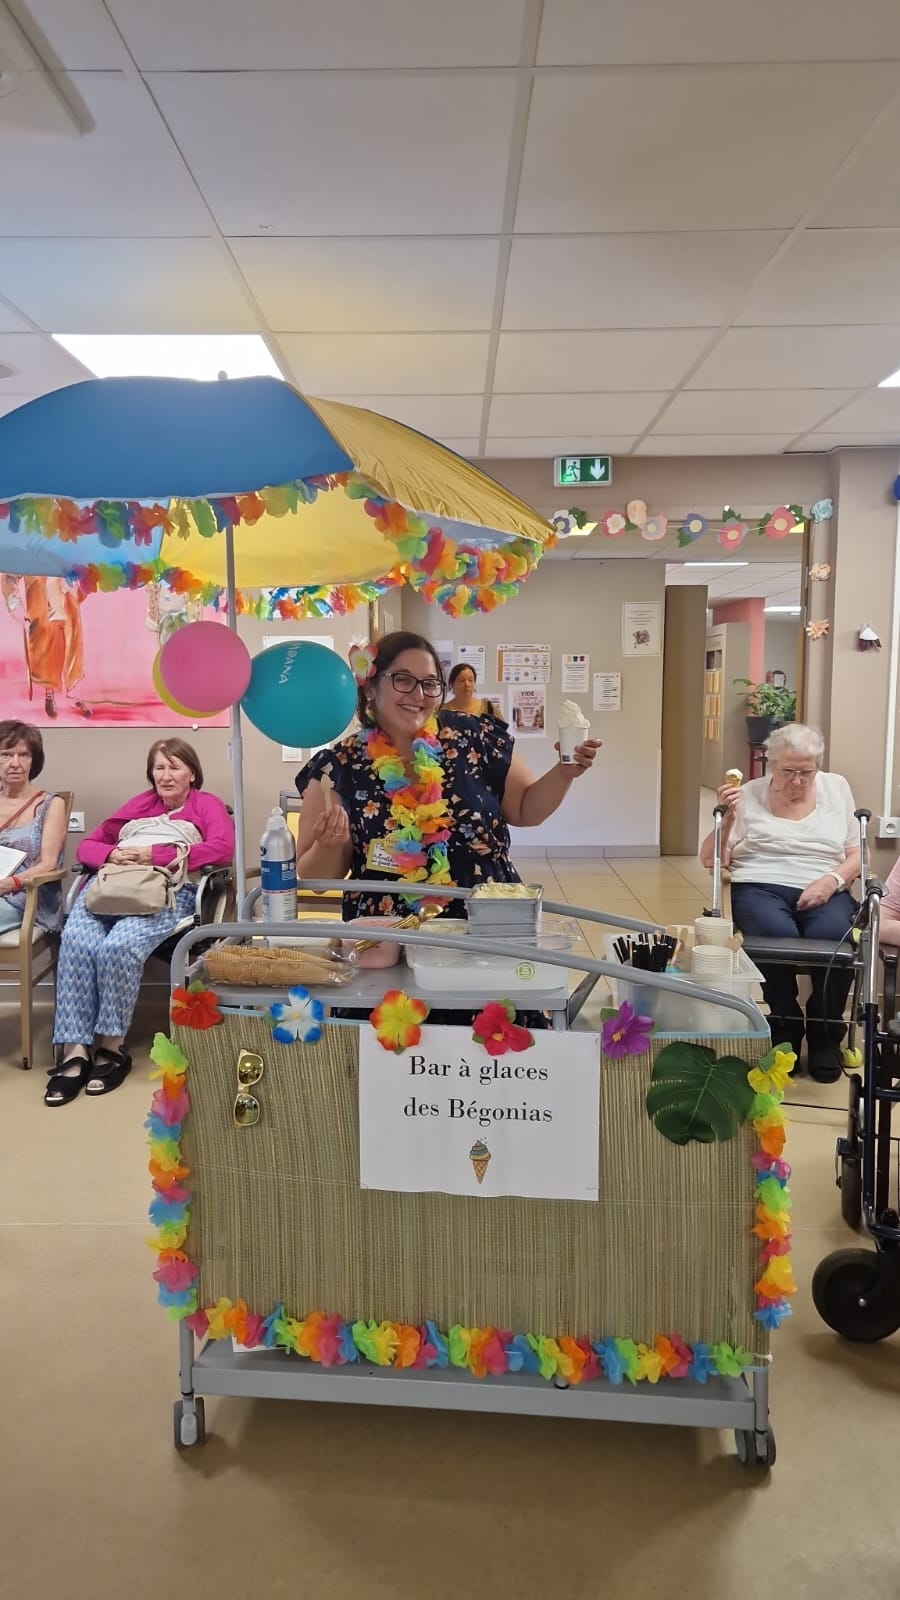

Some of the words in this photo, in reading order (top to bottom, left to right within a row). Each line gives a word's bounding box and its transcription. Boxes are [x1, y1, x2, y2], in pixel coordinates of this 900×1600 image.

[408, 1056, 451, 1077] Bar
[458, 1058, 471, 1078] à
[479, 1059, 548, 1085] glaces
[403, 1097, 439, 1117] des
[448, 1098, 552, 1127] Bégonias
